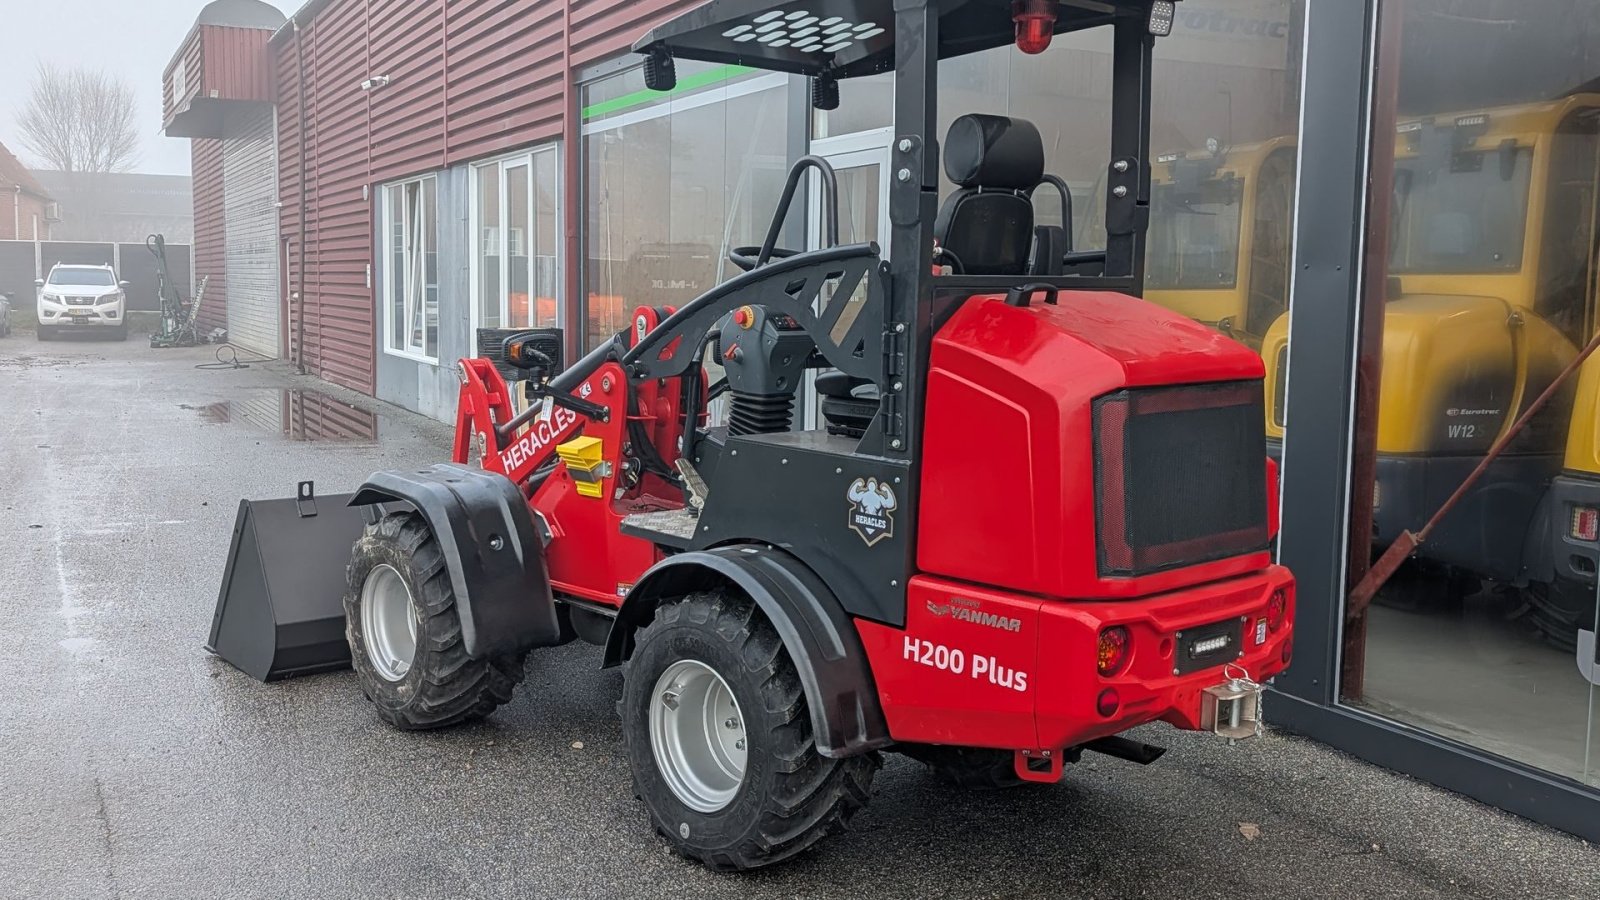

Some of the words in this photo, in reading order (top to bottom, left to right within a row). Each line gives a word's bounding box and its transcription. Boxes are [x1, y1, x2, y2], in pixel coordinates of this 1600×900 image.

[502, 406, 576, 475] HERACLES
[855, 514, 887, 529] HERACLES
[950, 605, 1021, 633] YANMAR
[903, 635, 965, 674] H200
[971, 654, 1028, 692] Plus
